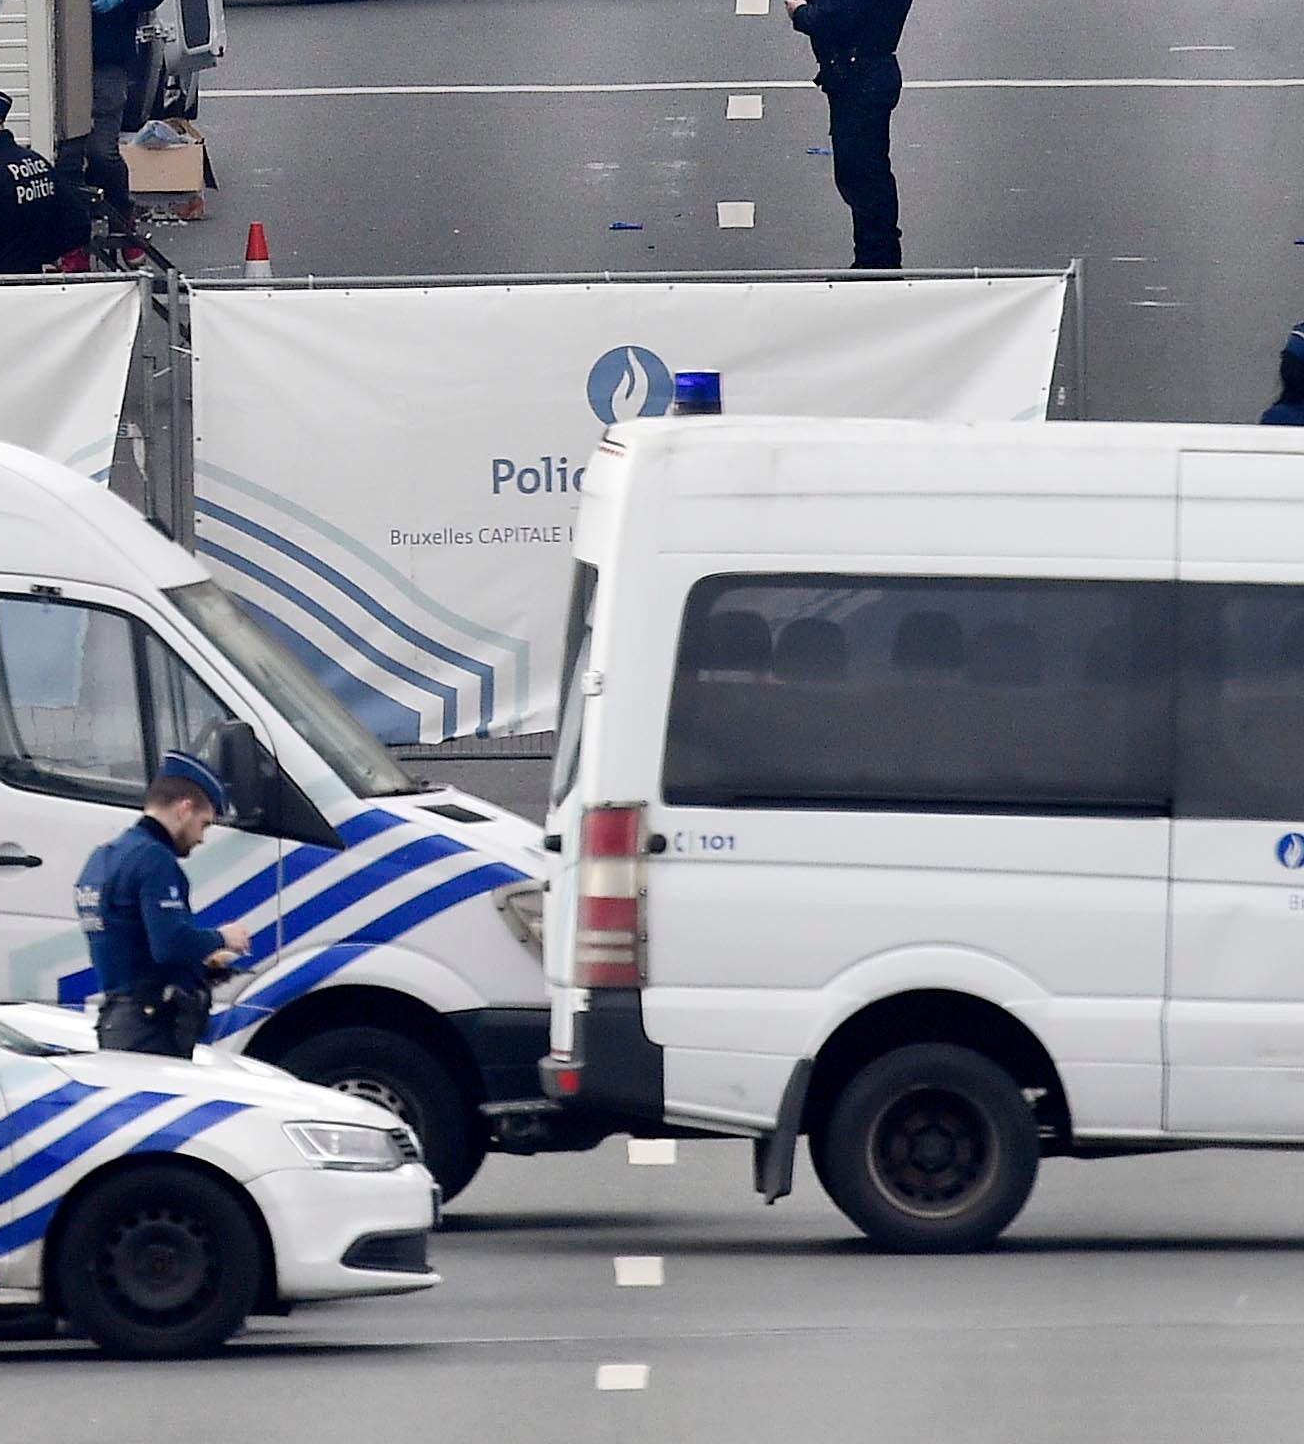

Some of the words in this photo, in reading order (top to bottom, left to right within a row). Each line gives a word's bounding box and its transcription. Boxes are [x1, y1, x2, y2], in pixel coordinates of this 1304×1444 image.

[8, 158, 48, 181] Police
[16, 178, 56, 204] Politie
[391, 528, 473, 546] Bruxelles
[478, 526, 561, 544] CAPITALE
[699, 835, 734, 850] 101
